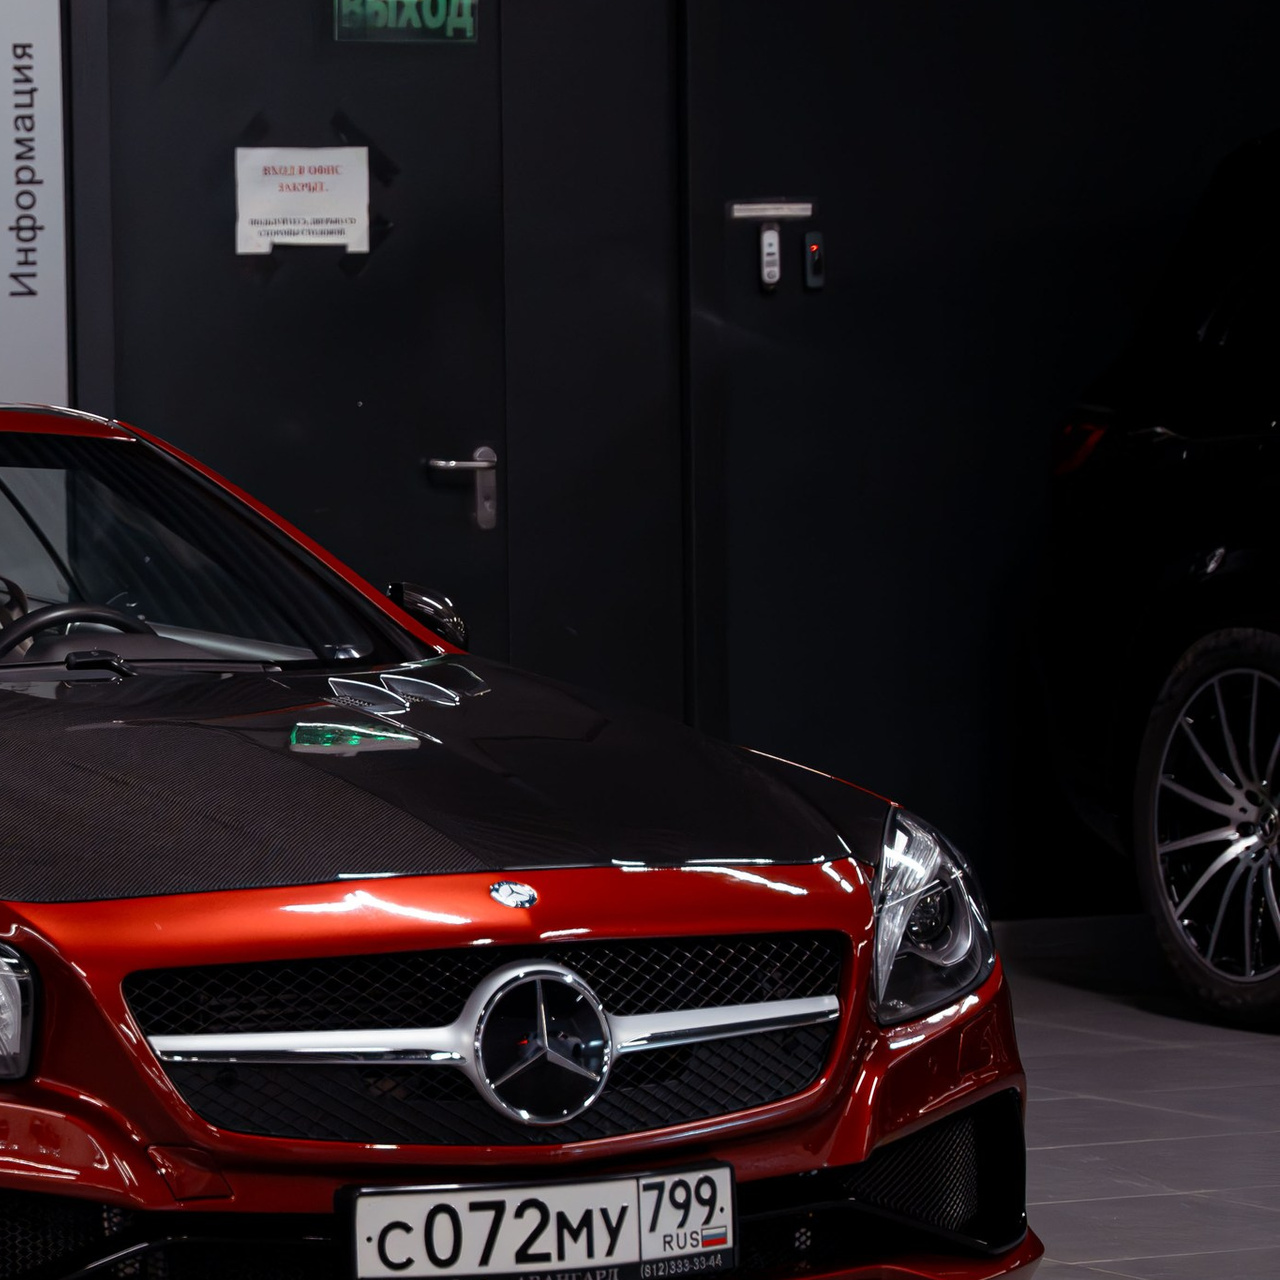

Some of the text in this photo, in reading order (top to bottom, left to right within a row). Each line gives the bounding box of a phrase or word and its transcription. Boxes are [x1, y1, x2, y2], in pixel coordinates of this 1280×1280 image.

[7, 42, 45, 297] Информация
[642, 1175, 718, 1234] 799
[663, 1230, 700, 1252] RUS
[640, 1253, 723, 1280] (812)333-33-44
